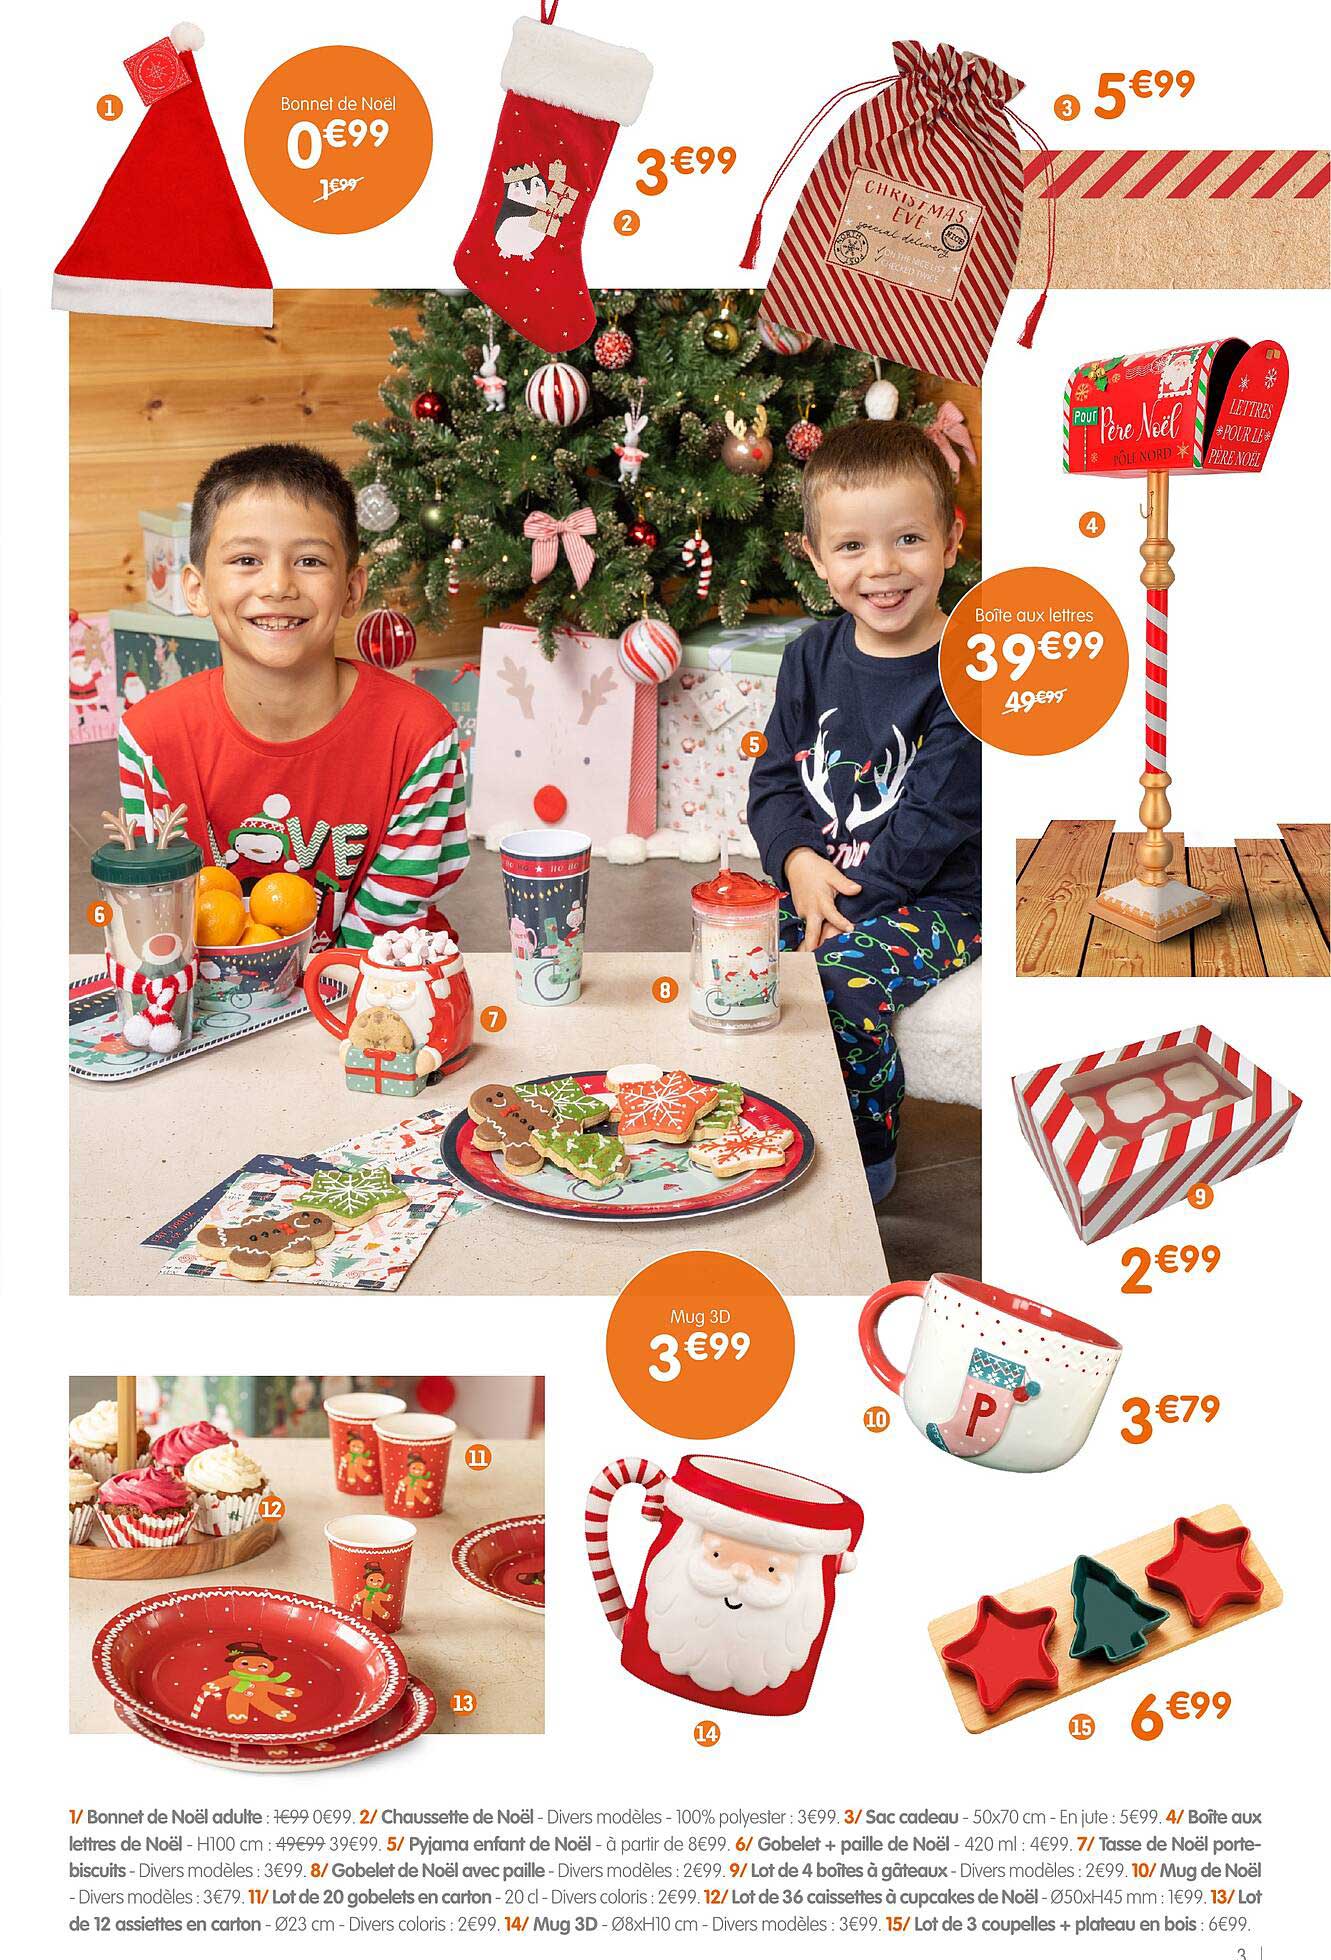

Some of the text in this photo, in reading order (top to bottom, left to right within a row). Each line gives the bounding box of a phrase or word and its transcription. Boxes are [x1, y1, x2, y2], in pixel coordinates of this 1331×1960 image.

[280, 96, 396, 111] Bonnet de Noël
[1094, 69, 1196, 120] 5€99
[103, 99, 115, 117] 1
[1062, 99, 1073, 117] 3
[287, 118, 389, 170] 0€99
[635, 145, 737, 196] 3€99
[864, 180, 968, 224] CHRISTMAS
[621, 214, 632, 232] 2
[892, 206, 928, 230] EVE
[944, 230, 966, 246] NICE
[1229, 398, 1273, 420] LETTRES
[1100, 399, 1183, 444] Père Noël
[1222, 424, 1265, 444] POUR LE
[1208, 445, 1235, 465] PÈRE
[1085, 517, 1099, 534] 4
[975, 607, 1094, 623] Boîte aux lettres
[965, 630, 1104, 682] 39€99
[749, 736, 760, 753] 5
[94, 905, 105, 923] 6
[660, 981, 671, 999] 8
[488, 1011, 499, 1028] 7
[1195, 1188, 1206, 1205] 9
[1120, 1244, 1221, 1295] 2€99
[670, 1309, 731, 1327] Mug 3D
[648, 1331, 751, 1382] 3€99
[867, 1410, 887, 1429] 10
[965, 1392, 996, 1438] P
[1120, 1394, 1221, 1445] 3€79
[469, 1450, 488, 1465] 11
[262, 1502, 282, 1518] 12
[454, 1696, 473, 1711] 13
[1130, 1690, 1232, 1742] 6€99
[696, 1726, 718, 1743] 14
[1072, 1718, 1093, 1737] 15
[68, 1809, 86, 1824] 1/
[87, 1809, 145, 1824] Bonnet
[146, 1808, 169, 1824] de
[171, 1808, 209, 1824] Noël
[211, 1808, 263, 1824] adulte
[358, 1808, 378, 1824] 2/
[380, 1808, 470, 1824] Chaussette
[472, 1808, 494, 1824] de
[497, 1808, 534, 1824] Noël
[547, 1809, 593, 1824] Divers
[596, 1808, 663, 1824] modèles
[675, 1809, 716, 1824] 100%
[719, 1808, 787, 1828] polyester
[843, 1808, 864, 1824] 3/
[865, 1809, 896, 1824] Sac
[898, 1808, 959, 1824] cadeau
[972, 1809, 1019, 1824] 50x70
[1022, 1811, 1046, 1824] cm
[1059, 1809, 1078, 1824] En
[1081, 1809, 1109, 1828] jute
[1164, 1808, 1185, 1824] 4/
[1188, 1809, 1229, 1824] Boîte
[1230, 1813, 1263, 1824] aux
[68, 1836, 117, 1851] lettres
[120, 1836, 142, 1851] de
[145, 1835, 183, 1851] Noël
[197, 1836, 236, 1852] H100
[239, 1840, 264, 1851] cm
[385, 1836, 406, 1852] 5/
[409, 1836, 470, 1855] Pyjama
[472, 1836, 527, 1851] enfant
[528, 1836, 551, 1851] de
[554, 1836, 592, 1851] Noël
[606, 1836, 617, 1851] à
[621, 1837, 660, 1855] partir
[663, 1836, 684, 1851] de
[734, 1836, 754, 1852] 6/
[757, 1836, 822, 1851] Gobelet
[824, 1840, 837, 1851] +
[840, 1835, 884, 1855] paille
[887, 1836, 909, 1851] de
[912, 1835, 950, 1851] Noël
[964, 1836, 994, 1851] 420
[998, 1836, 1017, 1851] ml
[1076, 1836, 1096, 1852] 7/
[1098, 1837, 1143, 1851] Tasse
[1145, 1836, 1168, 1851] de
[1171, 1836, 1209, 1851] Noël
[1212, 1837, 1262, 1855] porte-
[68, 1916, 91, 1931] de
[93, 1916, 112, 1931] 12
[114, 1916, 183, 1931] assiettes
[185, 1920, 207, 1931] en
[210, 1917, 262, 1931] carton
[311, 1920, 337, 1931] cm
[349, 1916, 395, 1931] Divers
[398, 1915, 447, 1931] coloris
[503, 1915, 530, 1932] 14/
[532, 1917, 571, 1935] Mug
[574, 1917, 599, 1931] 3D
[674, 1920, 698, 1931] cm
[712, 1917, 759, 1931] Divers
[761, 1915, 828, 1931] modèles
[884, 1915, 913, 1932] 15/
[914, 1916, 940, 1931] Lot
[941, 1916, 964, 1931] de
[966, 1916, 978, 1931] 3
[981, 1916, 1057, 1935] coupelles
[1059, 1921, 1072, 1931] +
[1075, 1915, 1136, 1935] plateau
[1139, 1920, 1161, 1931] en
[1164, 1916, 1198, 1931] bois
